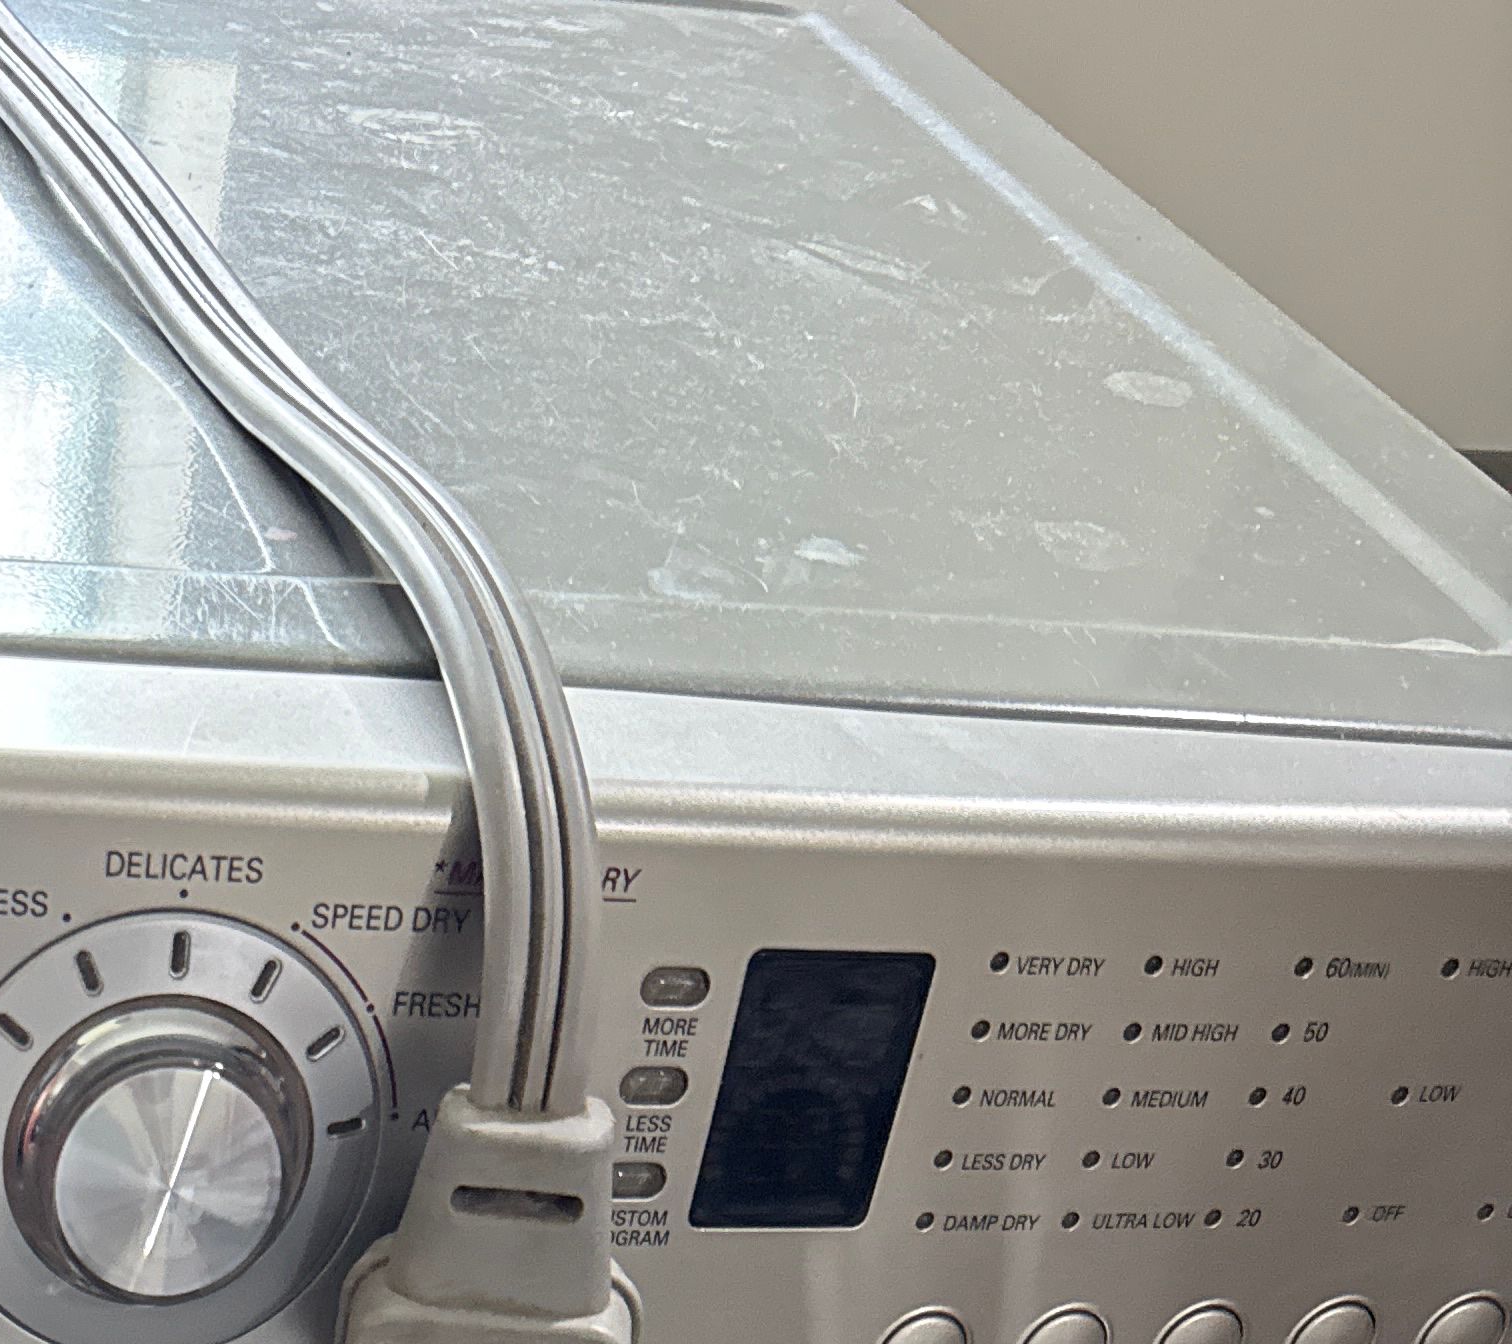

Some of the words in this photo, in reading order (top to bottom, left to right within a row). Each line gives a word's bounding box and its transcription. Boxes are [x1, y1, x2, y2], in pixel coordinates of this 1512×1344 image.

[105, 851, 264, 884] DELICATES
[602, 867, 642, 893] RY
[311, 903, 403, 931] SPEED
[411, 908, 471, 934] DRY
[1016, 957, 1064, 975] VERY
[1067, 958, 1106, 977] DRY
[1171, 959, 1220, 977] HIGH
[642, 1018, 699, 1036] MORE
[998, 1023, 1051, 1041] MORE
[1054, 1024, 1093, 1041] DRY
[1151, 1024, 1188, 1041] MID
[1191, 1024, 1239, 1041] HIGH
[1303, 1022, 1329, 1042] 50
[644, 1040, 688, 1058] TIME
[980, 1090, 1056, 1108] NORMAL
[1131, 1091, 1208, 1108] MEDIUM
[1282, 1086, 1306, 1105] 40
[1419, 1085, 1462, 1103] LOW
[626, 1116, 672, 1133] LESS
[624, 1137, 668, 1153] TIME
[961, 1154, 1005, 1170] LESS
[1010, 1154, 1046, 1170] DRY
[1111, 1152, 1155, 1169] LOW
[1258, 1151, 1283, 1170] 30
[612, 1210, 668, 1227] STOM
[943, 1215, 998, 1231] DAMP
[1002, 1214, 1040, 1231] DRY
[1093, 1214, 1147, 1230] ULTRA
[1153, 1213, 1195, 1229] LOW
[1236, 1208, 1261, 1228] 20
[610, 1230, 670, 1246] GRAM
